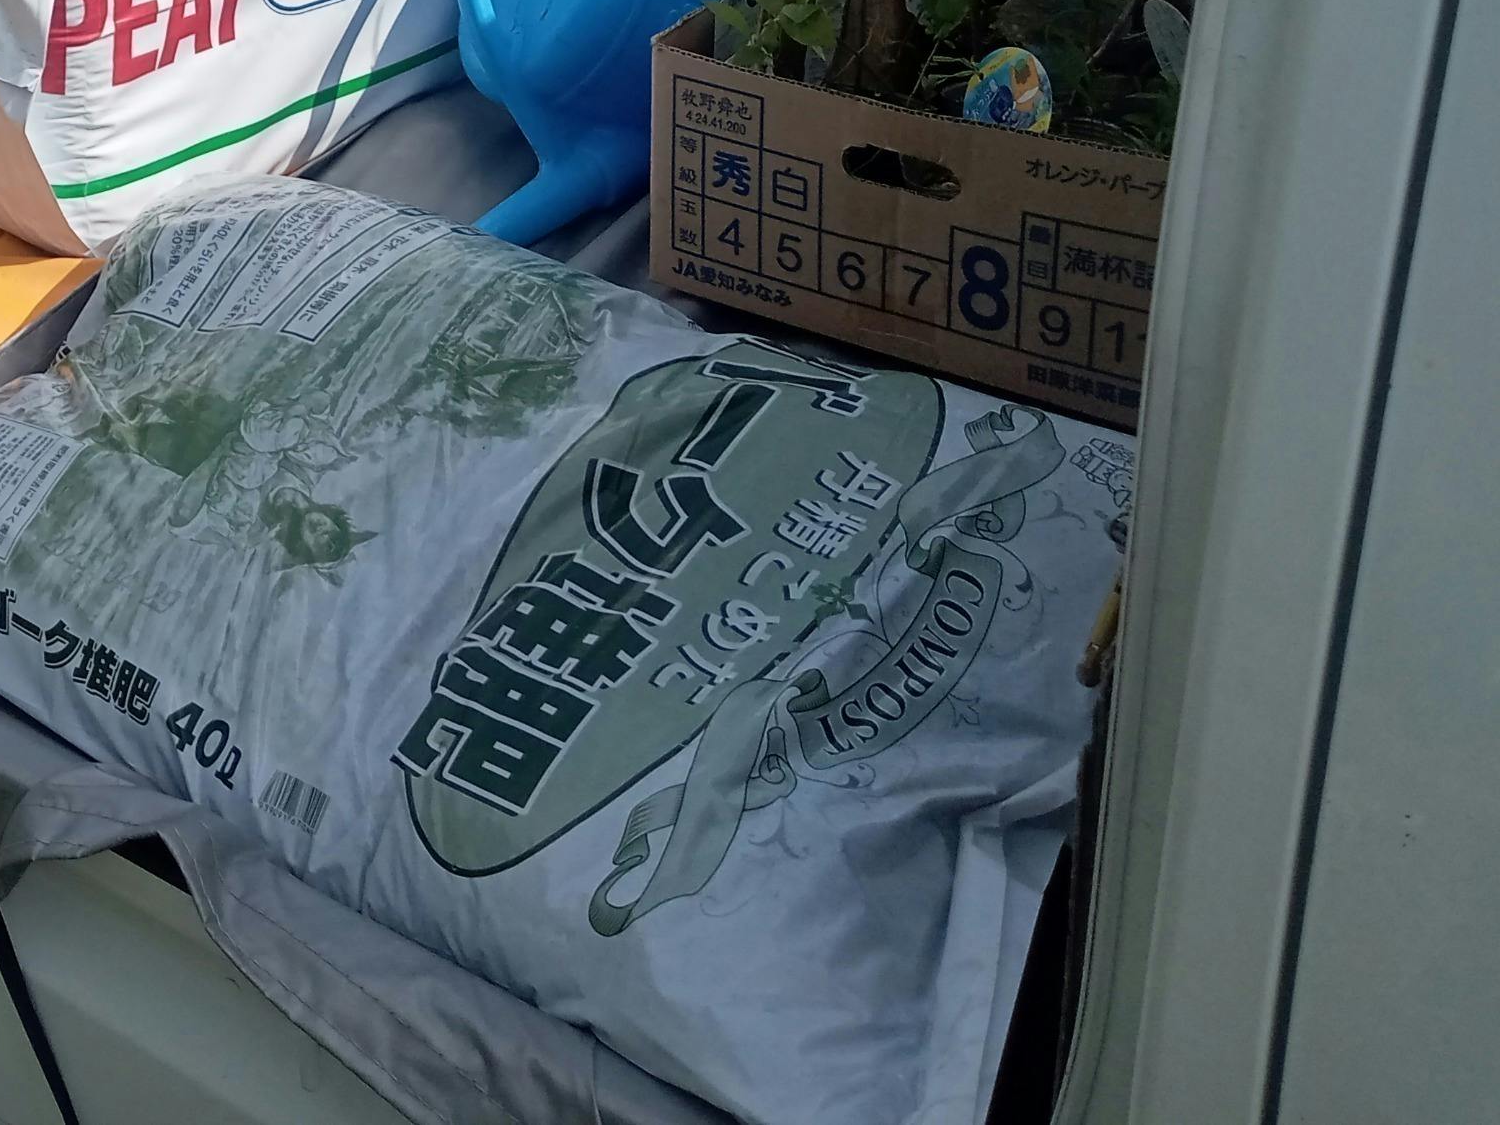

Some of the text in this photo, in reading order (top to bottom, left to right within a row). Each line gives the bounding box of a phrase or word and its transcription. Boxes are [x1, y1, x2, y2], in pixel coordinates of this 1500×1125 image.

[678, 135, 699, 187] 等級
[712, 150, 809, 212] 秀 白
[679, 198, 699, 248] 玉数
[671, 258, 792, 308] JA愛知みなみ
[717, 217, 1148, 363] 4 5 6 7 8 9 1
[650, 450, 903, 705] 丹精こめた
[817, 568, 986, 758] COMPOST
